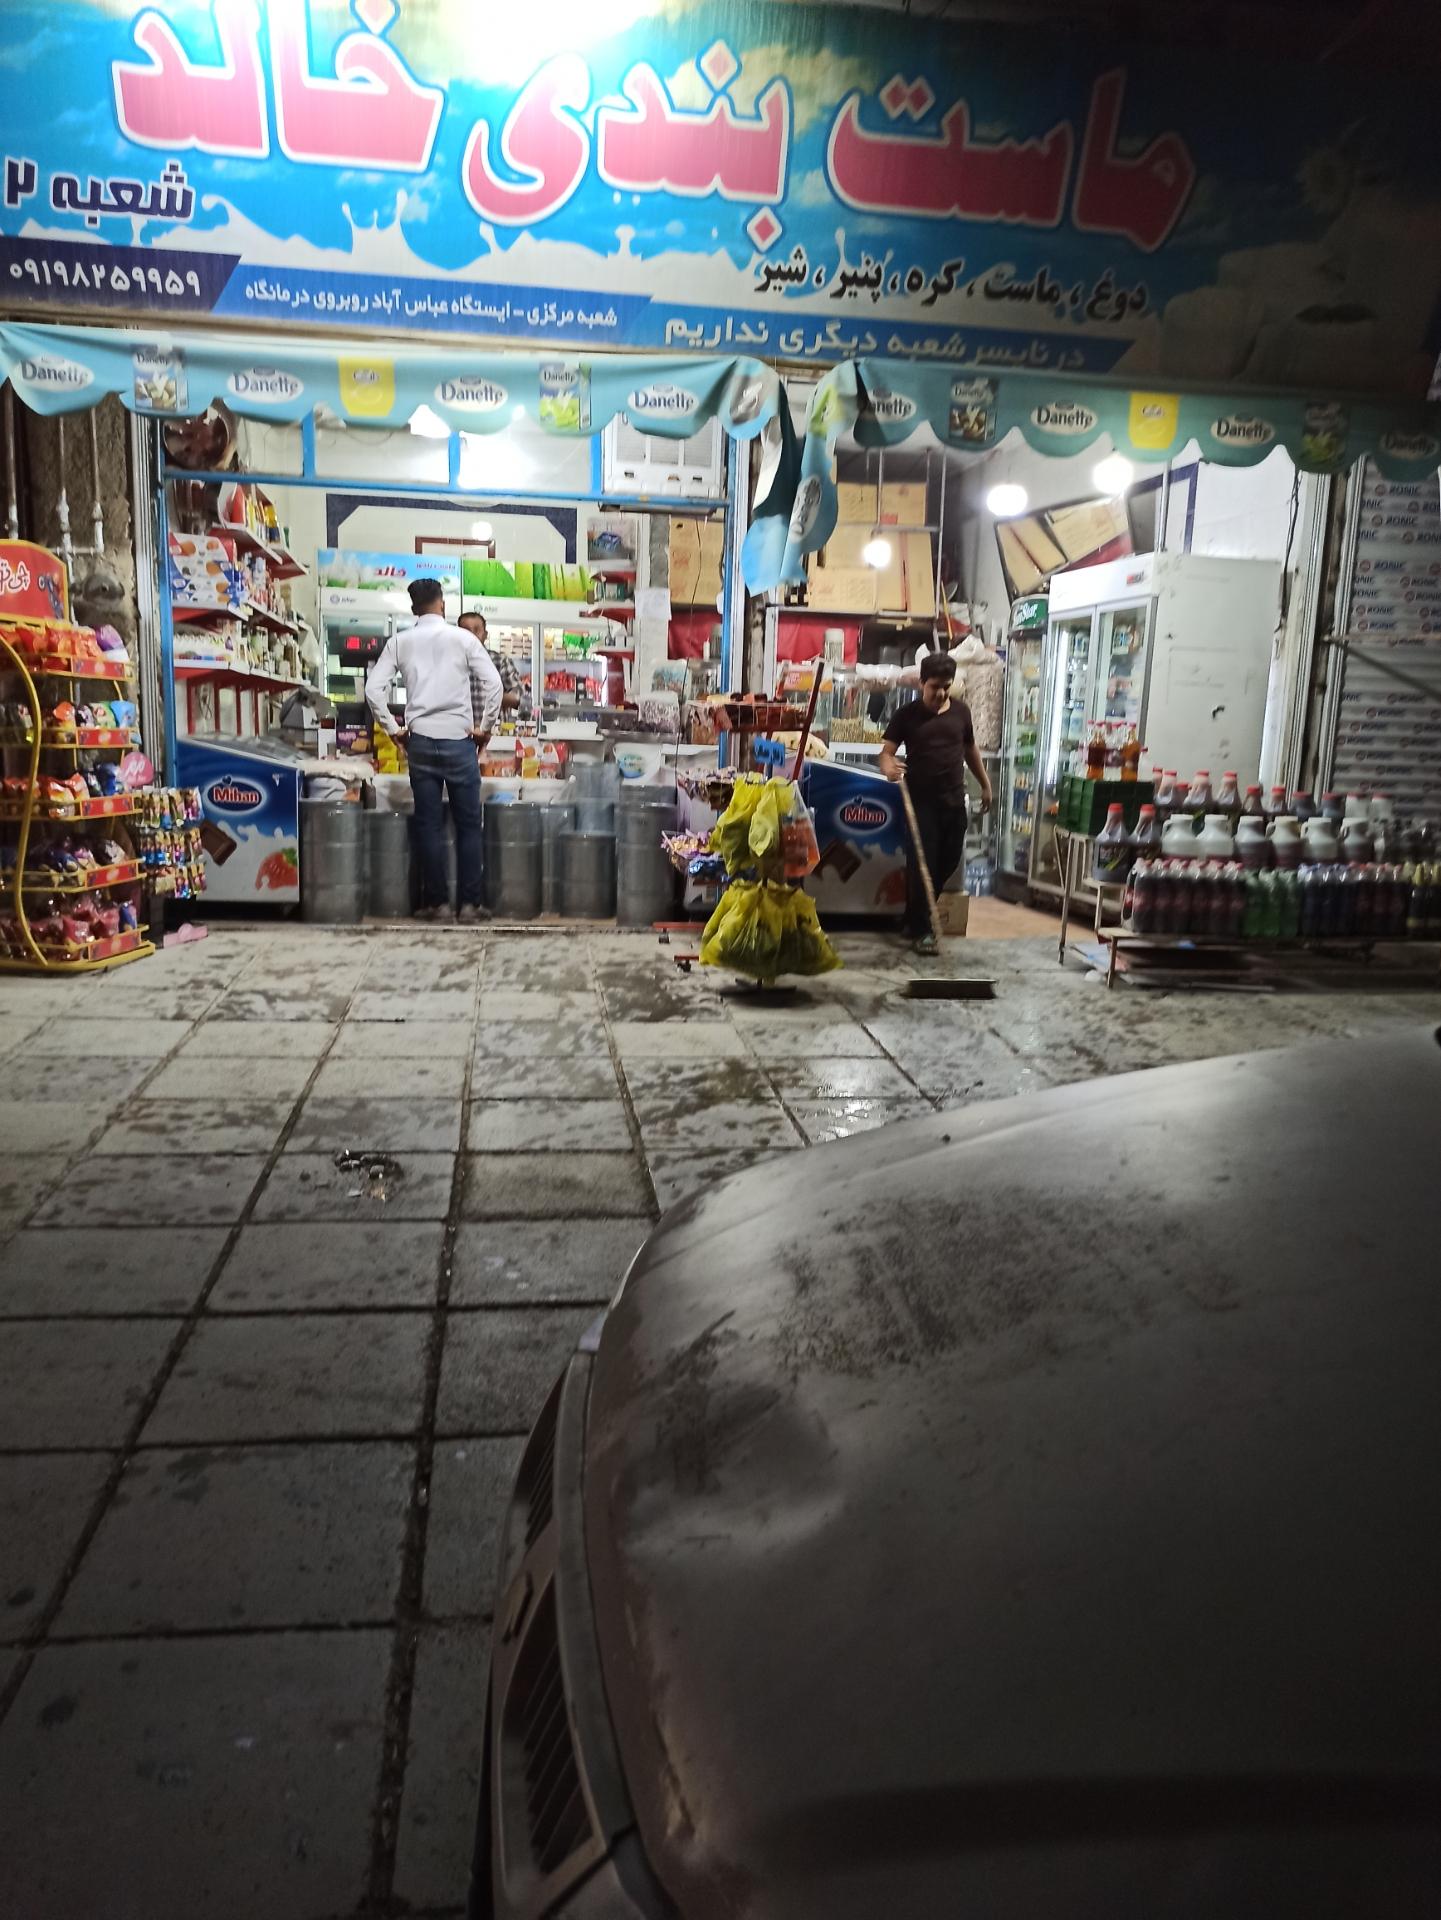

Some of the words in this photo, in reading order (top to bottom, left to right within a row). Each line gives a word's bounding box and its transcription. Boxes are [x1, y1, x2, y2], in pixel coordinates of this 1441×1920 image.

[112, 0, 445, 172] خالد
[462, 38, 793, 250] بندی
[826, 64, 1197, 253] ماست
[4, 155, 38, 208] ۲
[52, 159, 196, 229] شعبه
[9, 257, 201, 297] ۰۹۱۹۸۲۵۹۹۵۹
[754, 245, 808, 292] شیر
[313, 290, 369, 313] روبروی
[371, 288, 402, 315] آباد
[404, 294, 449, 318] عباس
[451, 294, 511, 324] ایستگاه
[526, 302, 574, 328] مرکزی
[576, 306, 618, 330] شعبه
[664, 315, 769, 348] نداریم
[779, 319, 879, 357] دیگری
[886, 331, 967, 363] شعبه
[20, 359, 90, 386] Danette
[1057, 346, 1086, 373] در
[234, 373, 300, 397] Danette
[441, 382, 504, 405] Danette
[634, 390, 696, 412] Danette
[1036, 405, 1094, 429] Danette
[1215, 416, 1272, 442] Danette
[213, 785, 260, 804] Mihan
